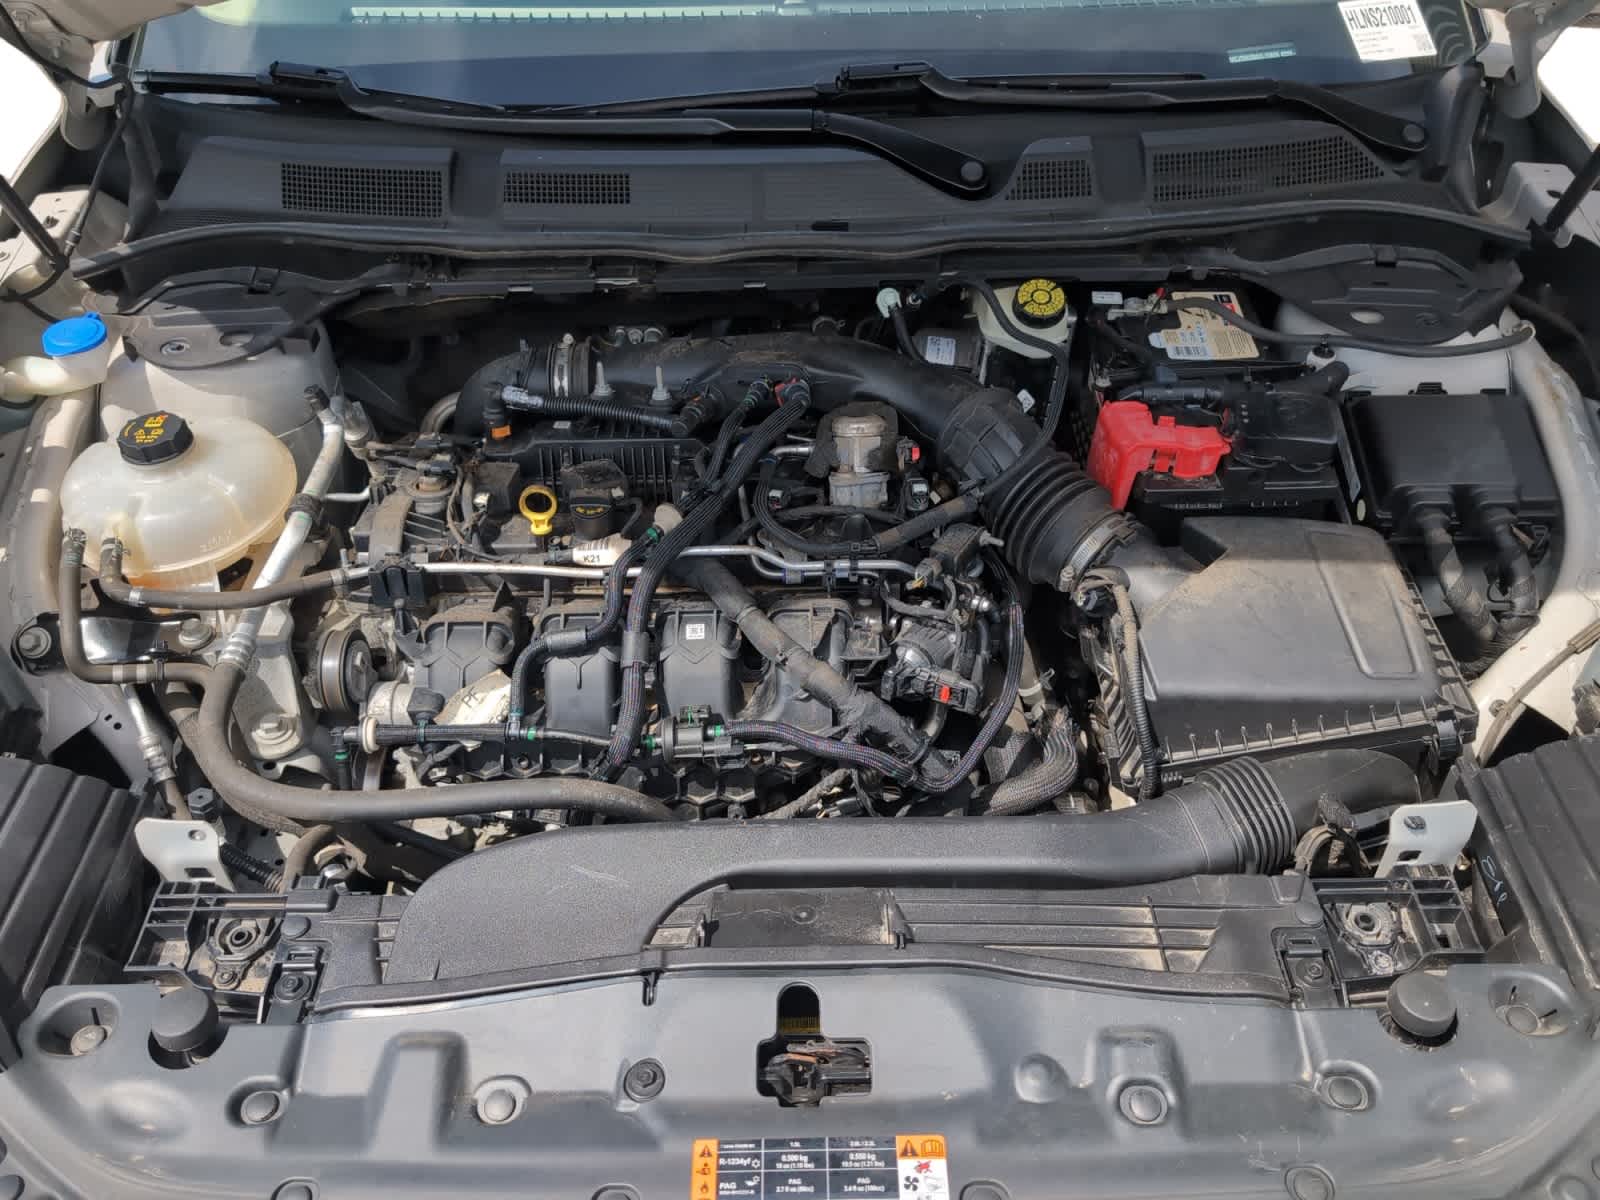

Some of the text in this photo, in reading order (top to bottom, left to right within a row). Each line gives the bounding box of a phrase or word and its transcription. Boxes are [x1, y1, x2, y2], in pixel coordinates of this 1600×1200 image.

[1344, 4, 1417, 31] HLNS210001
[583, 554, 601, 563] K21
[719, 1182, 737, 1190] PAG
